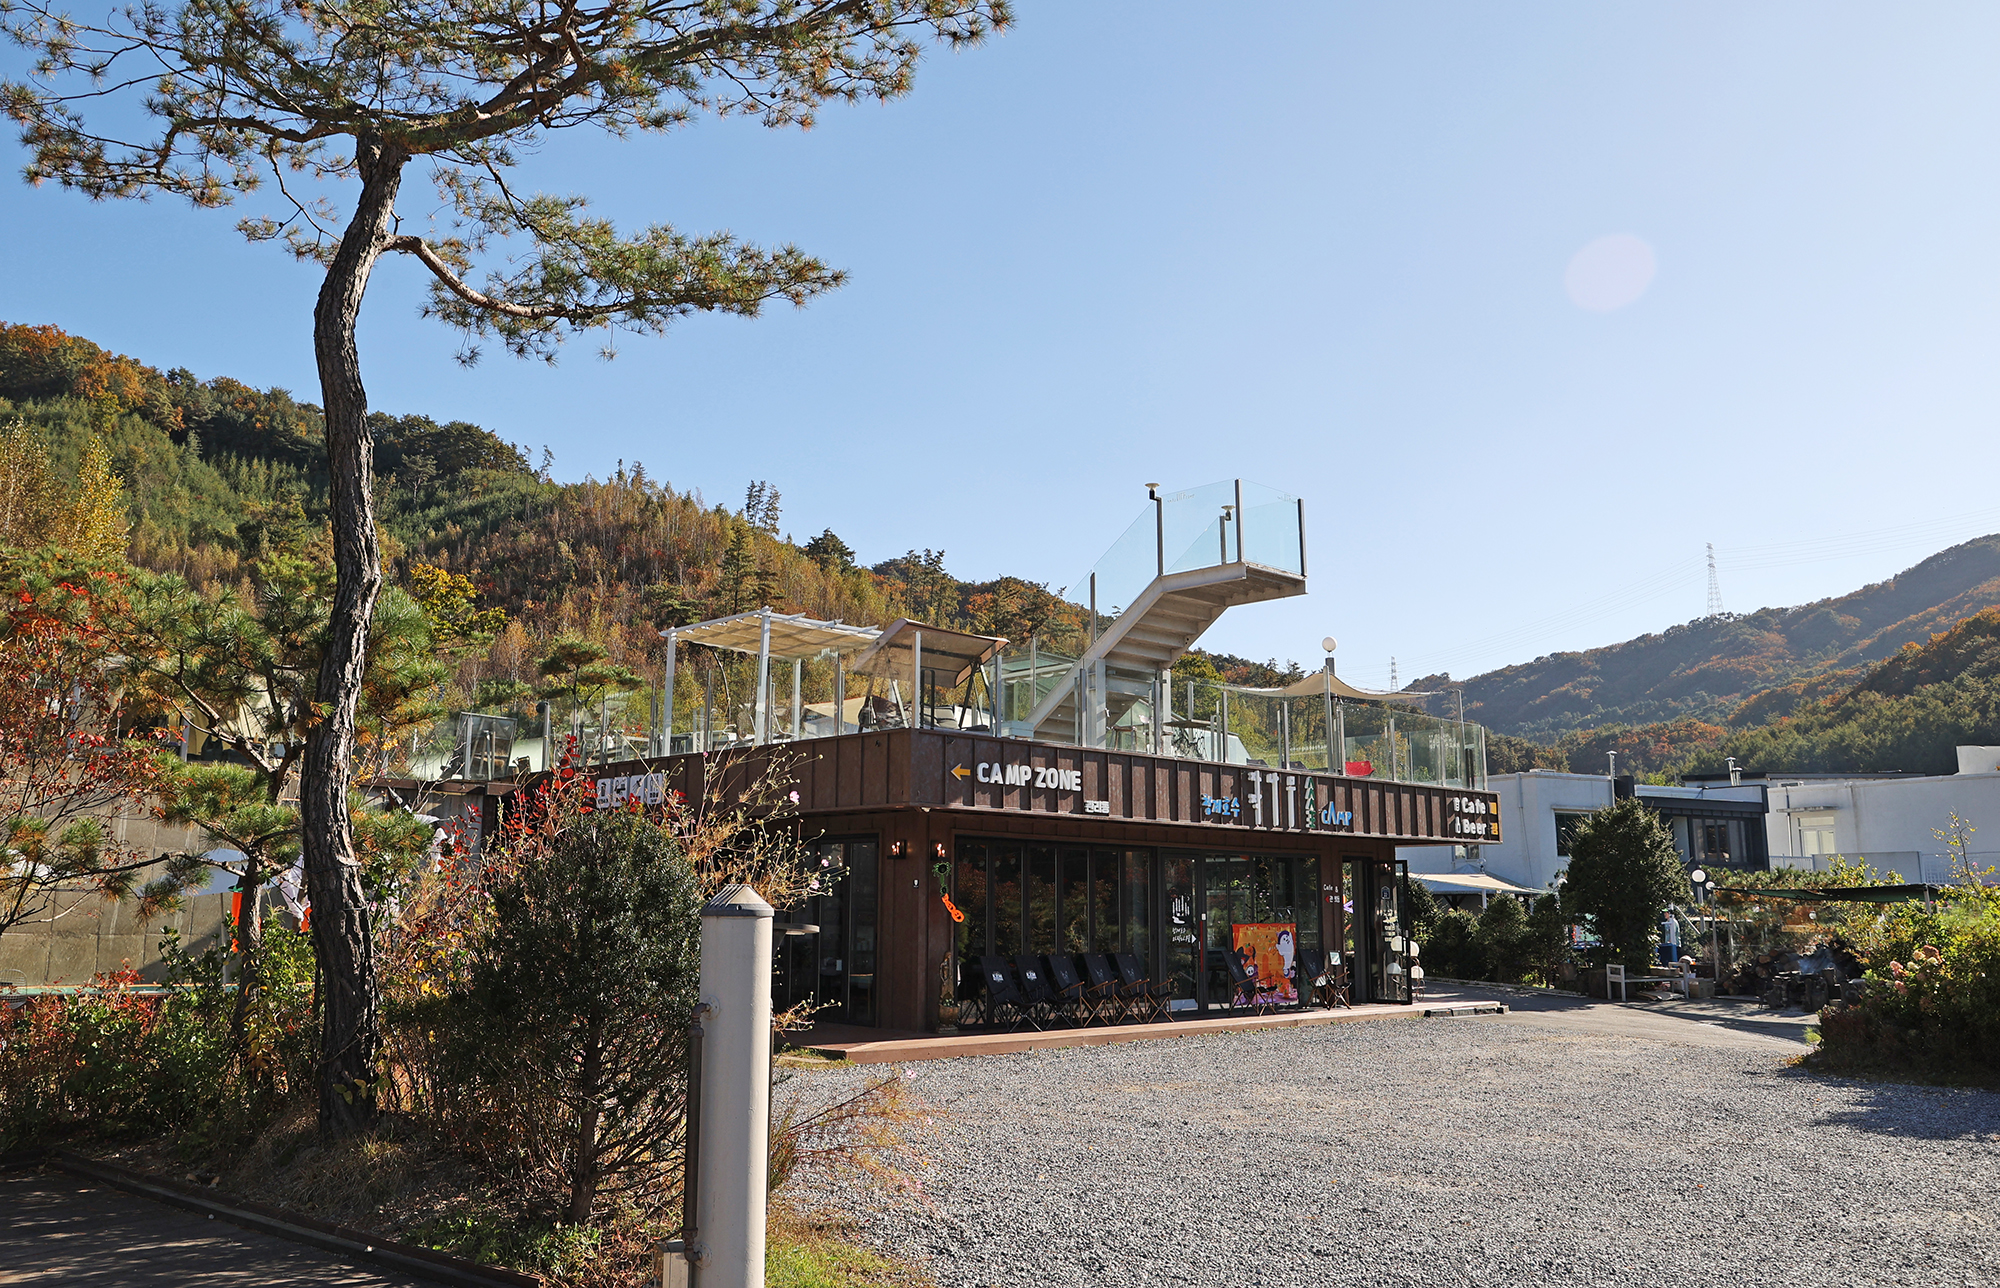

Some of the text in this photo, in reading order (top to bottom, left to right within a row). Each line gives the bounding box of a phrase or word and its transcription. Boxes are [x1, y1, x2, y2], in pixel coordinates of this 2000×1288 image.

[977, 762, 1082, 792] CAMP ZONE
[1201, 793, 1240, 817] 청계호수
[1321, 801, 1353, 826] CAMP
[1461, 796, 1486, 815] Cafe
[1462, 818, 1487, 835] Beer
